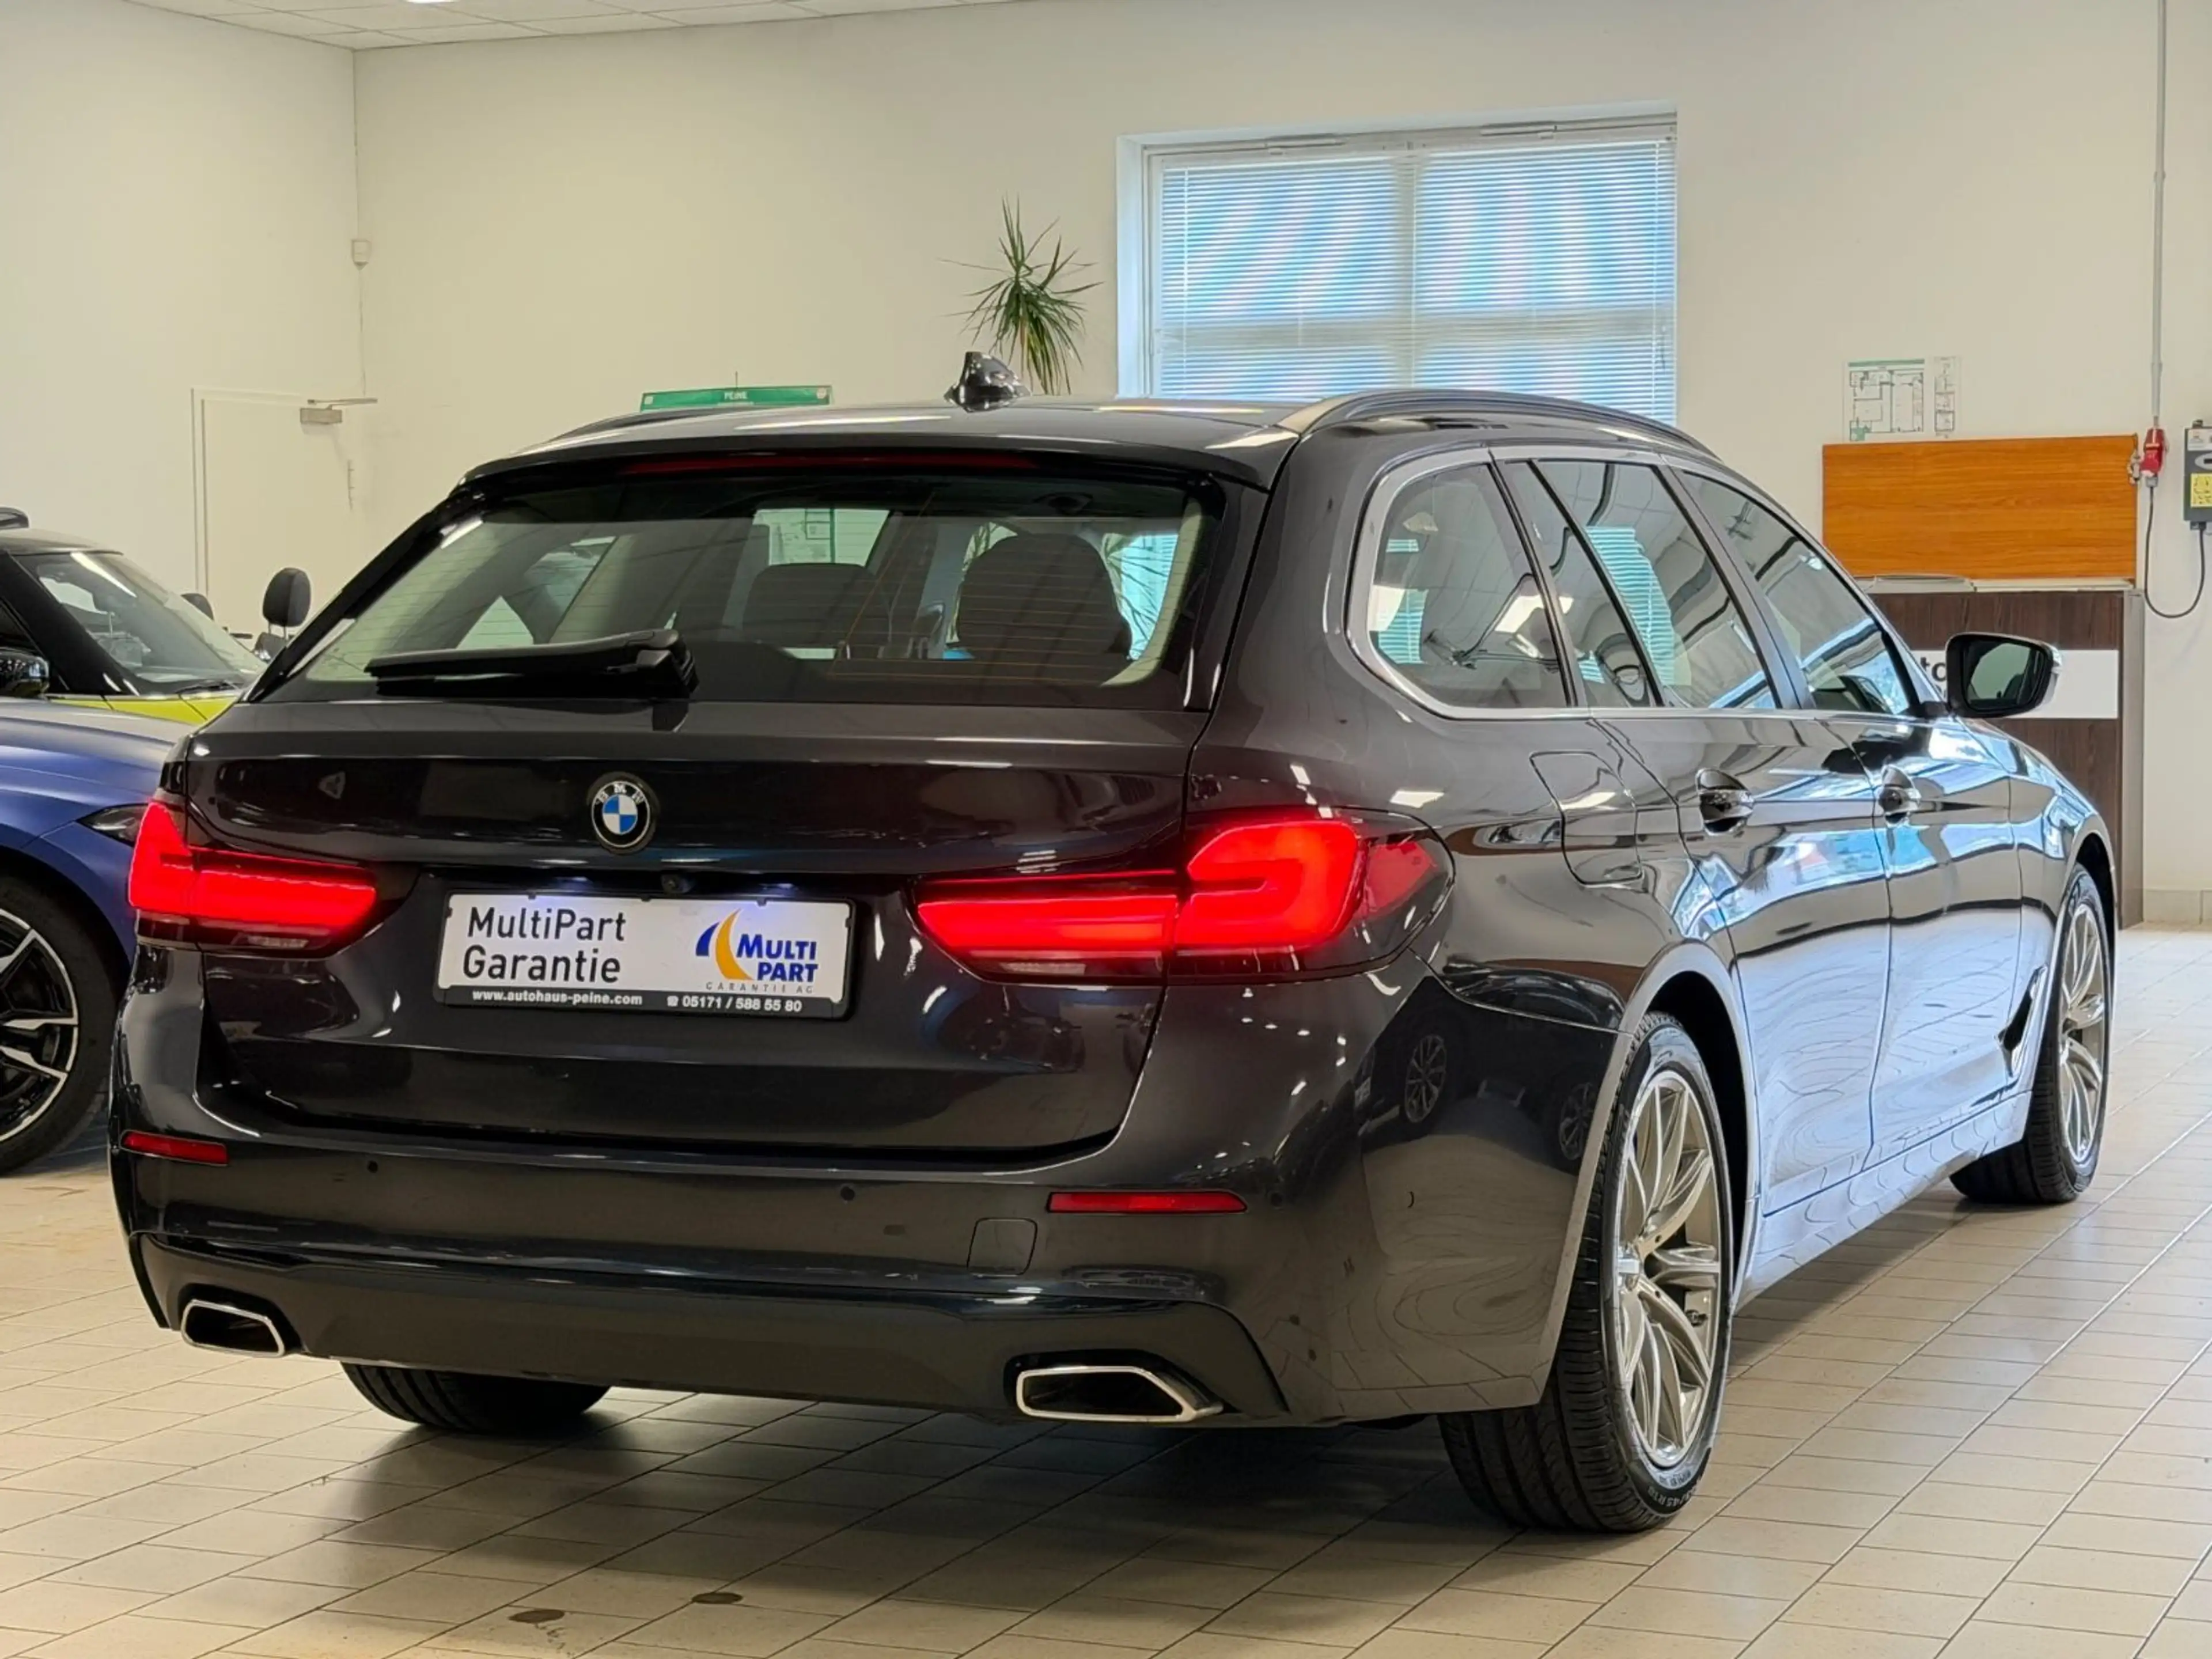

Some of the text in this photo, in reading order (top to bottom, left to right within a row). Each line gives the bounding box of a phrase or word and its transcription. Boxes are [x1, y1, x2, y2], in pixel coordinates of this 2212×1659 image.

[595, 783, 645, 805] BMW
[468, 907, 626, 941] MultiPart
[736, 934, 817, 960] MULTI
[463, 944, 620, 983] Garantie
[757, 961, 819, 982] PART
[472, 990, 642, 1005] www.autohaus-peine.com
[706, 982, 813, 994] GARANTIE AG
[682, 995, 721, 1008] 05171
[785, 1000, 802, 1012] 80
